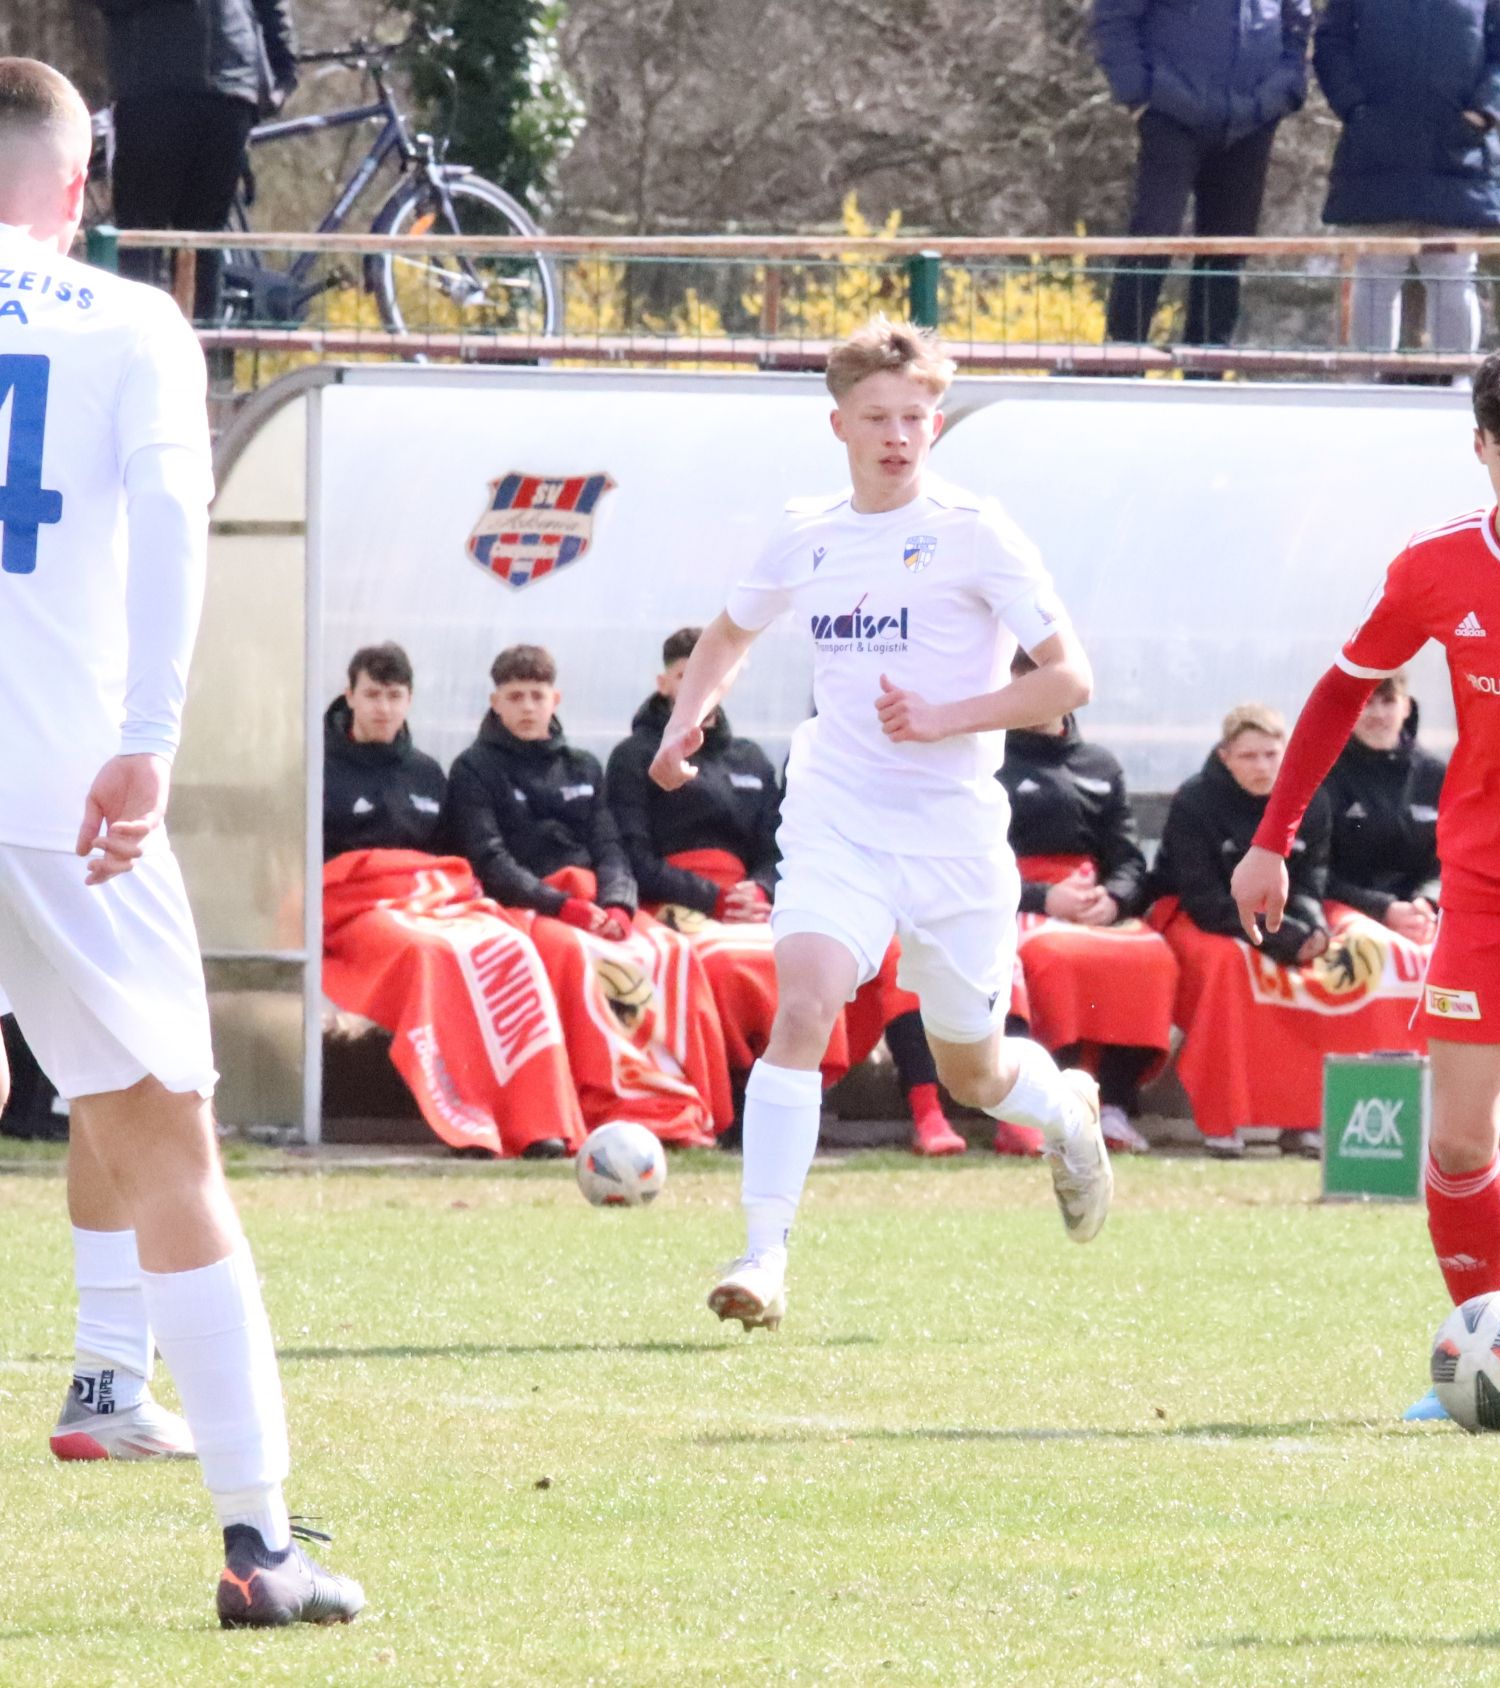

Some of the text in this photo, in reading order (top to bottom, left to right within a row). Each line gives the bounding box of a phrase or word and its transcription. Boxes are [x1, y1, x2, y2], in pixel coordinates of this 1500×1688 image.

[0, 268, 95, 310] ZEISS
[0, 353, 63, 575] 4
[532, 483, 564, 504] SV
[856, 641, 864, 653] &
[867, 642, 908, 655] Logistik
[469, 932, 551, 1067] UNION
[1340, 1098, 1405, 1146] AOK
